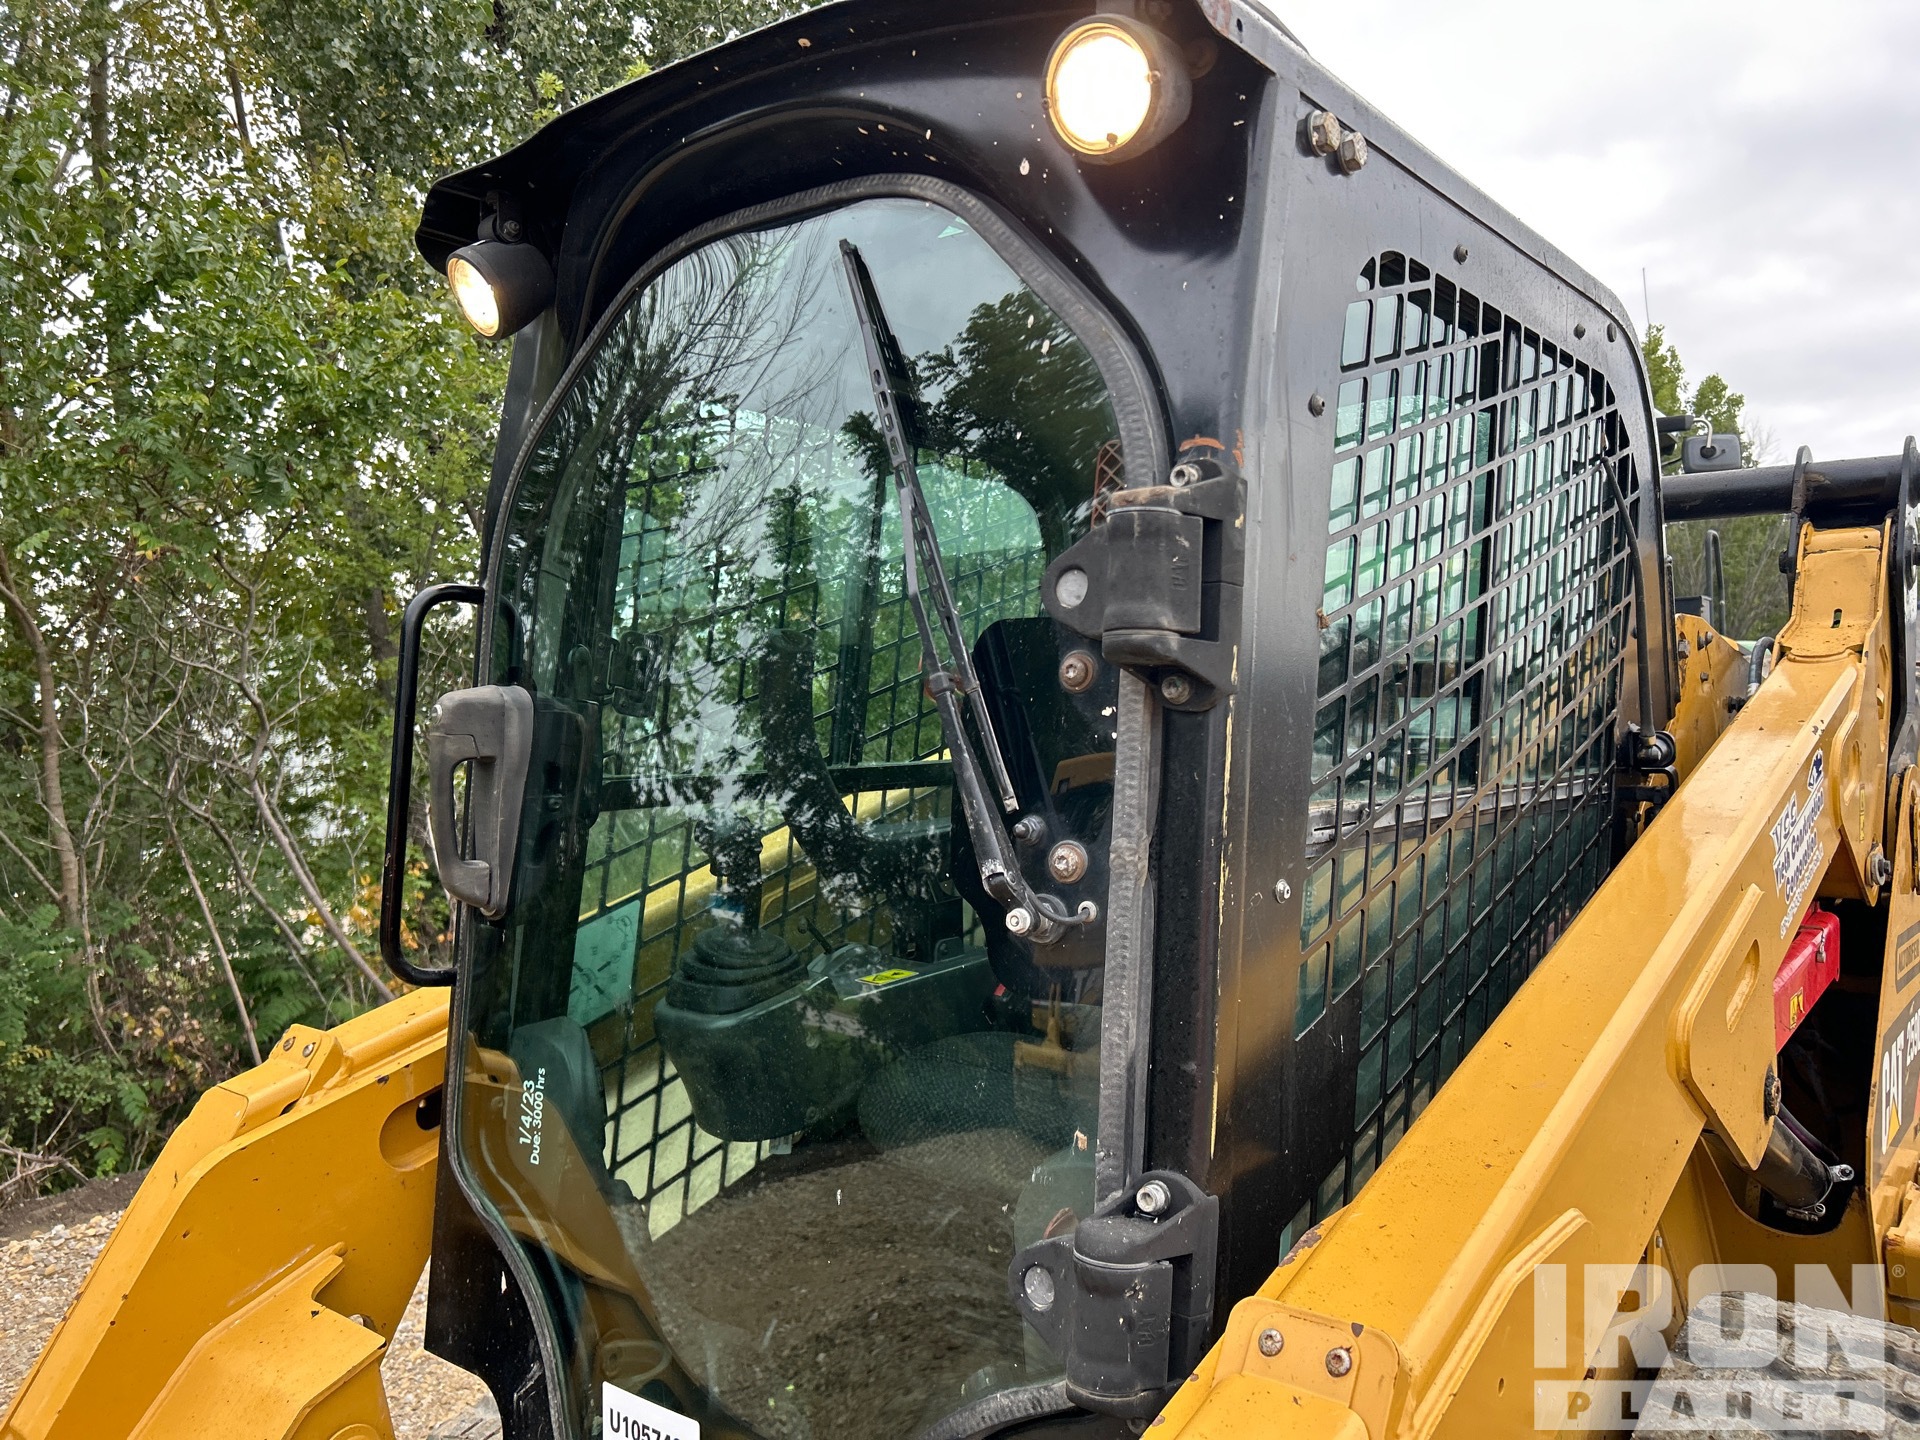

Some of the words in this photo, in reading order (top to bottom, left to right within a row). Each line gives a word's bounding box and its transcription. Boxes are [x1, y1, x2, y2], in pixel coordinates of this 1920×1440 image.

[536, 1067, 546, 1089] hrs
[1882, 1029, 1905, 1155] CAT
[519, 1079, 535, 1145] 1/4/23
[533, 1092, 544, 1129] 3000
[530, 1131, 542, 1165] Due:
[609, 1407, 680, 1440] U1057
